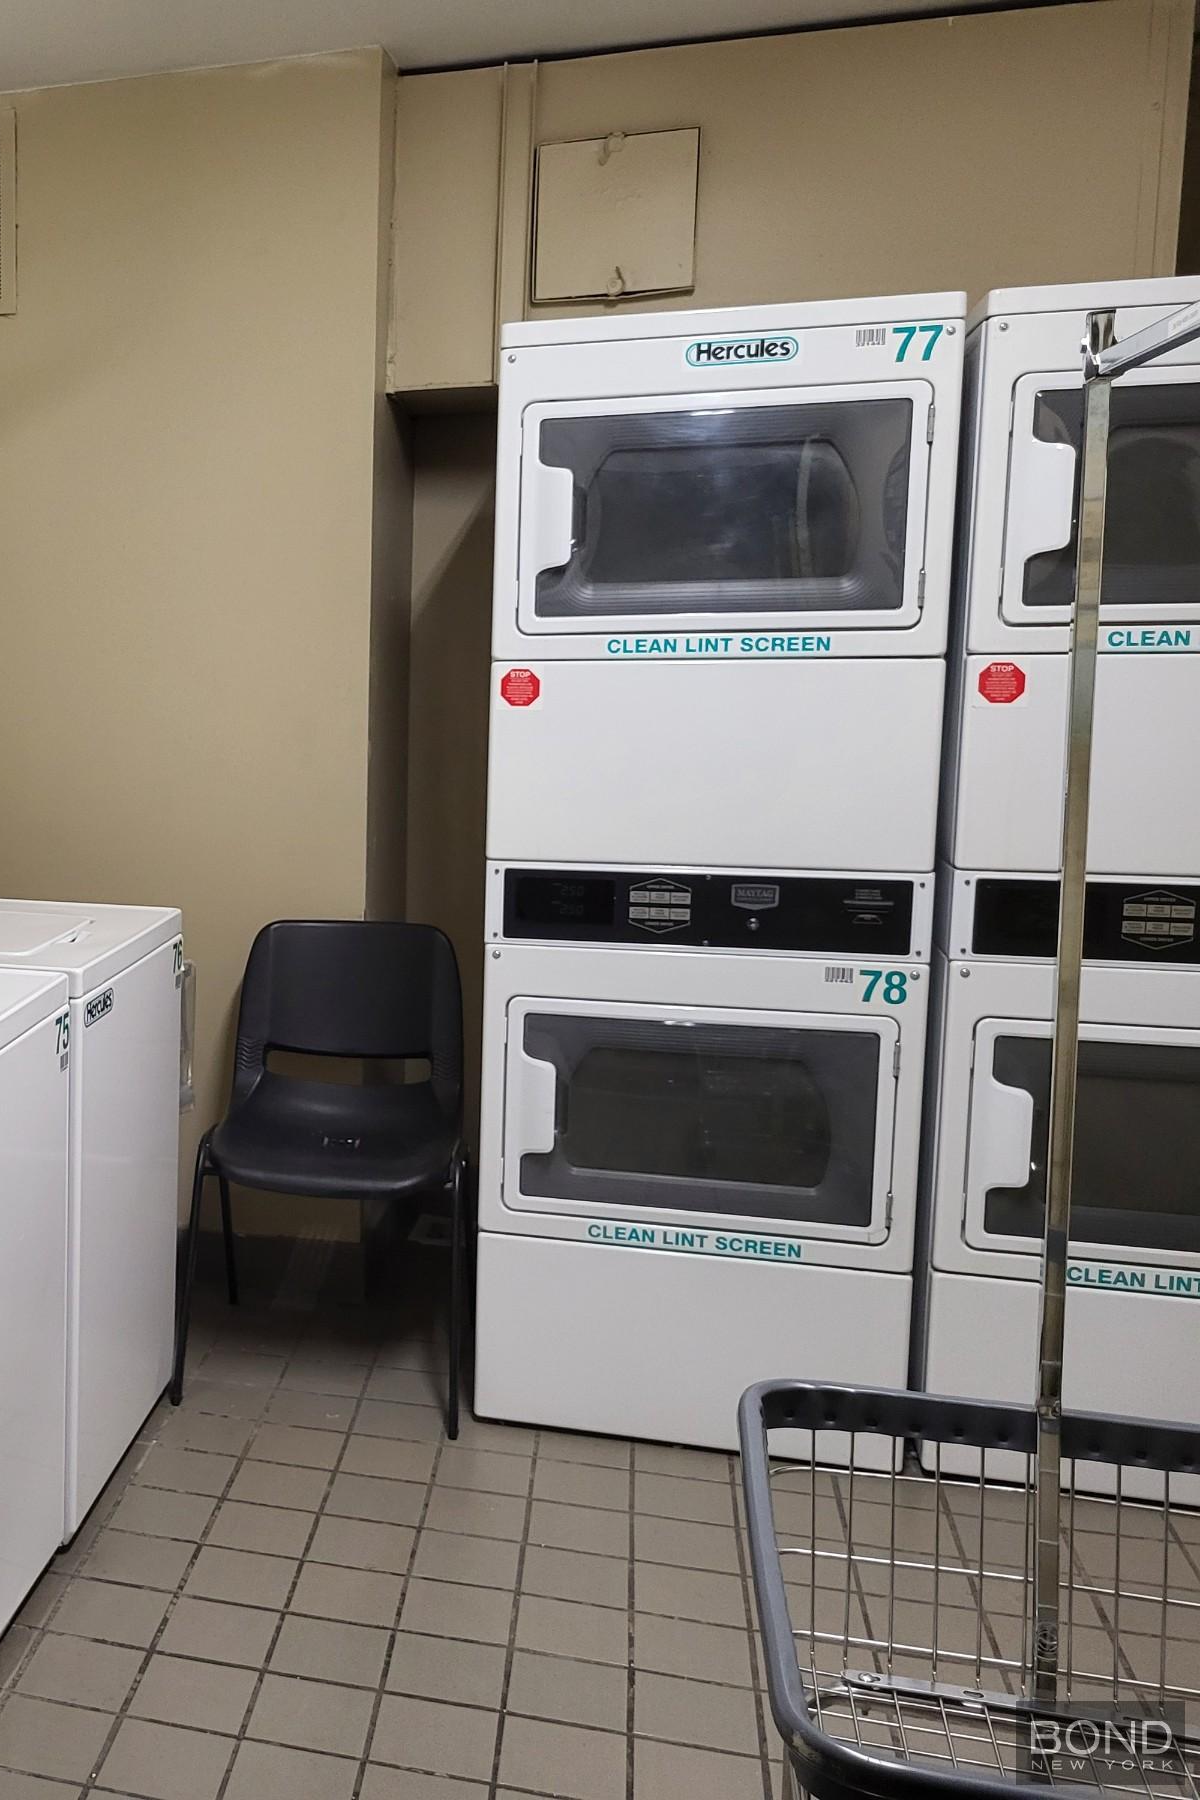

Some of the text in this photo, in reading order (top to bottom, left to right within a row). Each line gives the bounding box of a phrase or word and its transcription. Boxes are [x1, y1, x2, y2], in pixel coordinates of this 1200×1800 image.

[695, 337, 791, 362] Hercules
[892, 325, 944, 363] 77
[607, 636, 831, 655] CLEAN LINT SCREEN
[1107, 630, 1191, 646] CLEAN
[736, 889, 774, 898] MAYTAG
[859, 969, 907, 1005] 78
[86, 992, 112, 1024] Hercules
[55, 1012, 69, 1054] 75
[587, 1224, 802, 1259] CLEAN LINT SCREEN
[1067, 1266, 1146, 1288] CLEAN
